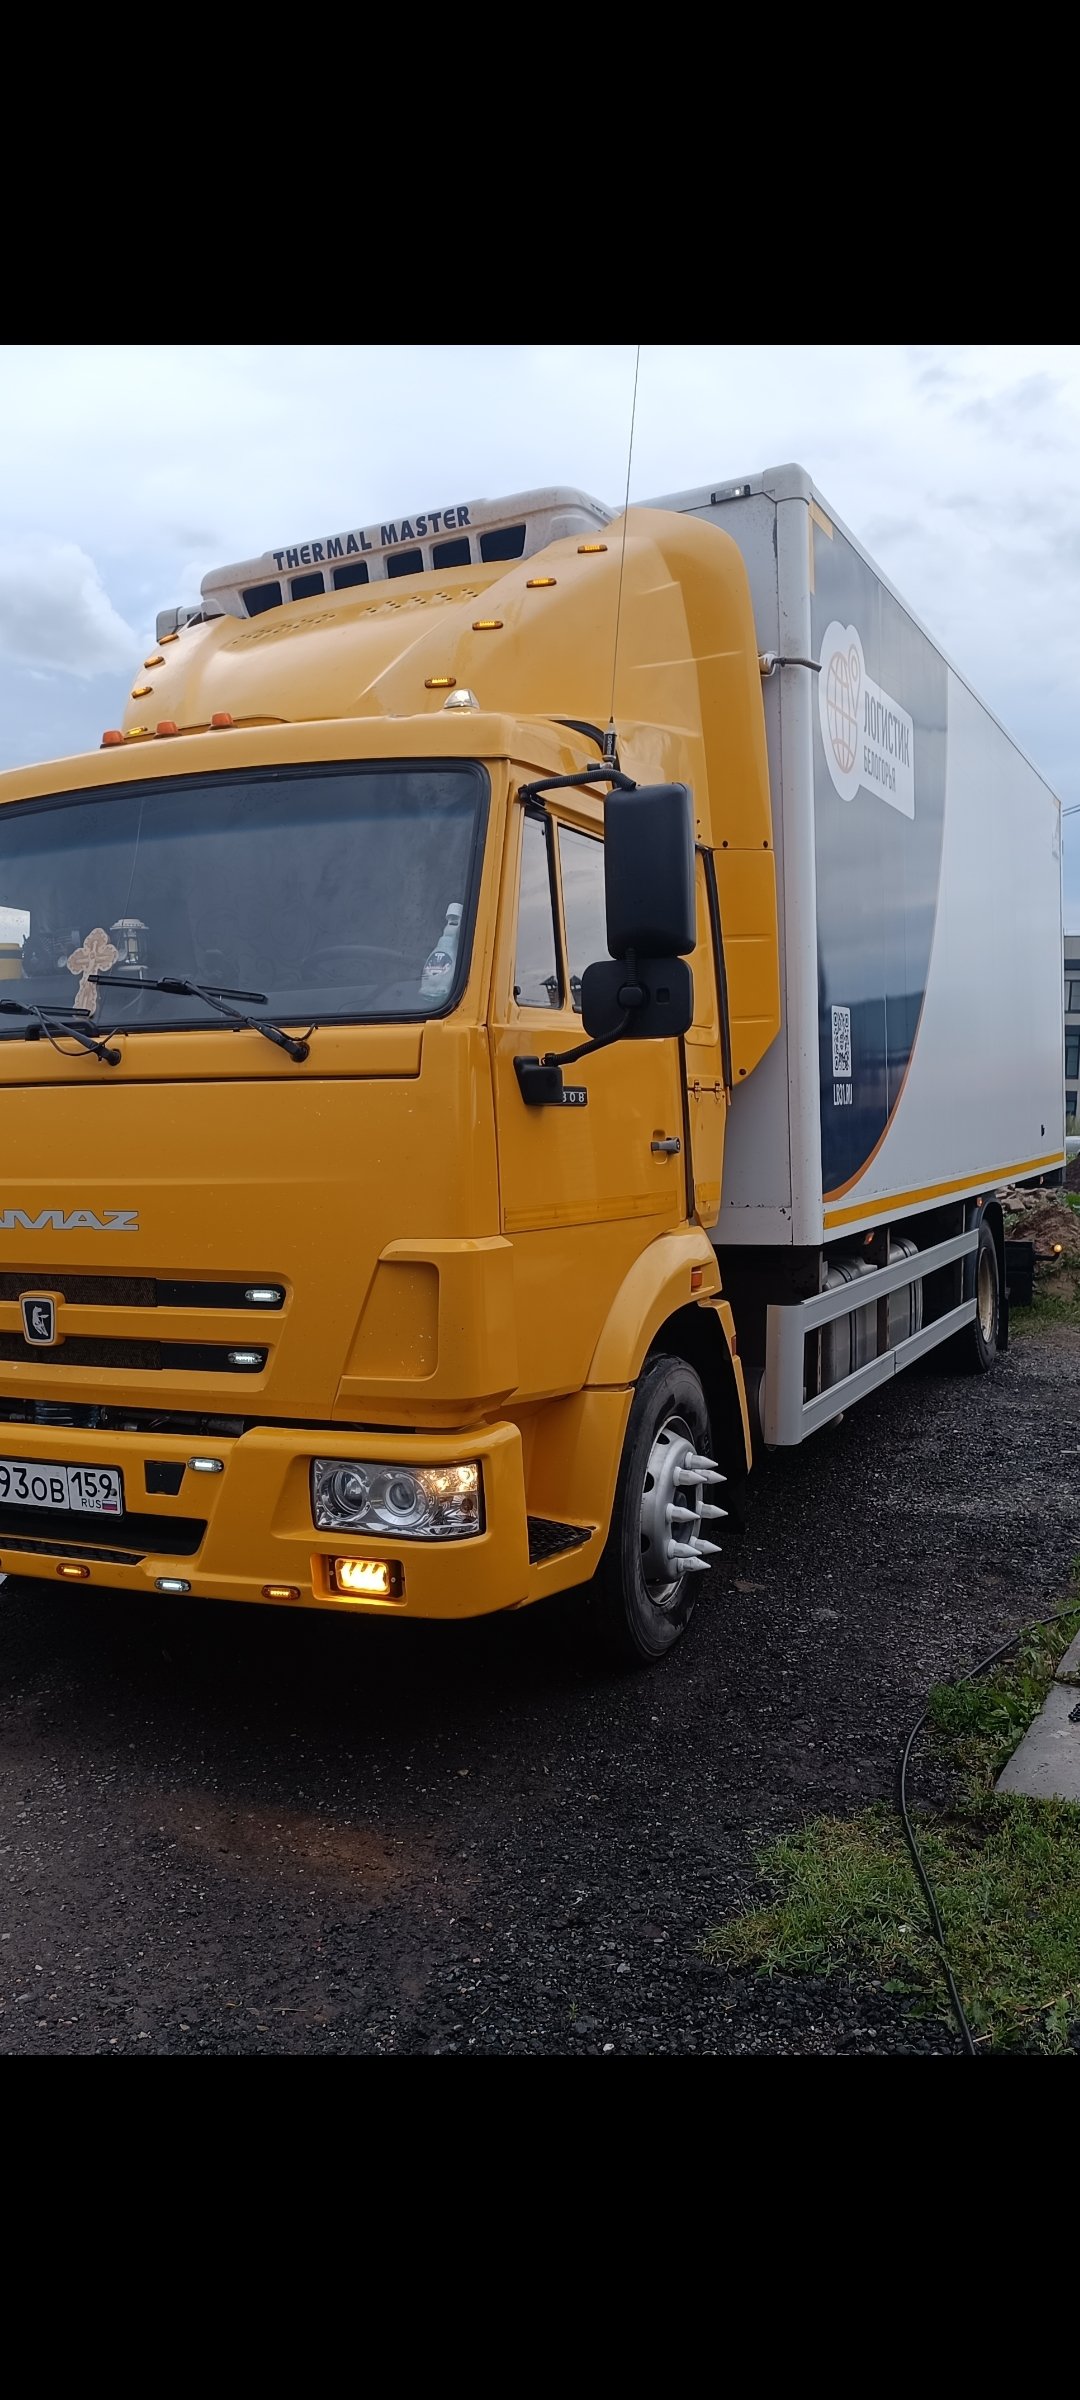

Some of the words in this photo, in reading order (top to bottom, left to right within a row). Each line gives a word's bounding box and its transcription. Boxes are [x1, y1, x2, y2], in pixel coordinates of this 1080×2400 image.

[273, 531, 372, 571] THERMAL
[380, 505, 471, 546] MASTER
[864, 690, 910, 768] ЛОГИСТИК
[863, 745, 896, 792] БЕЛОГОРЬЯ
[0, 1209, 139, 1231] MAZ
[70, 1471, 113, 1499] 159
[81, 1498, 102, 1509] RUS
